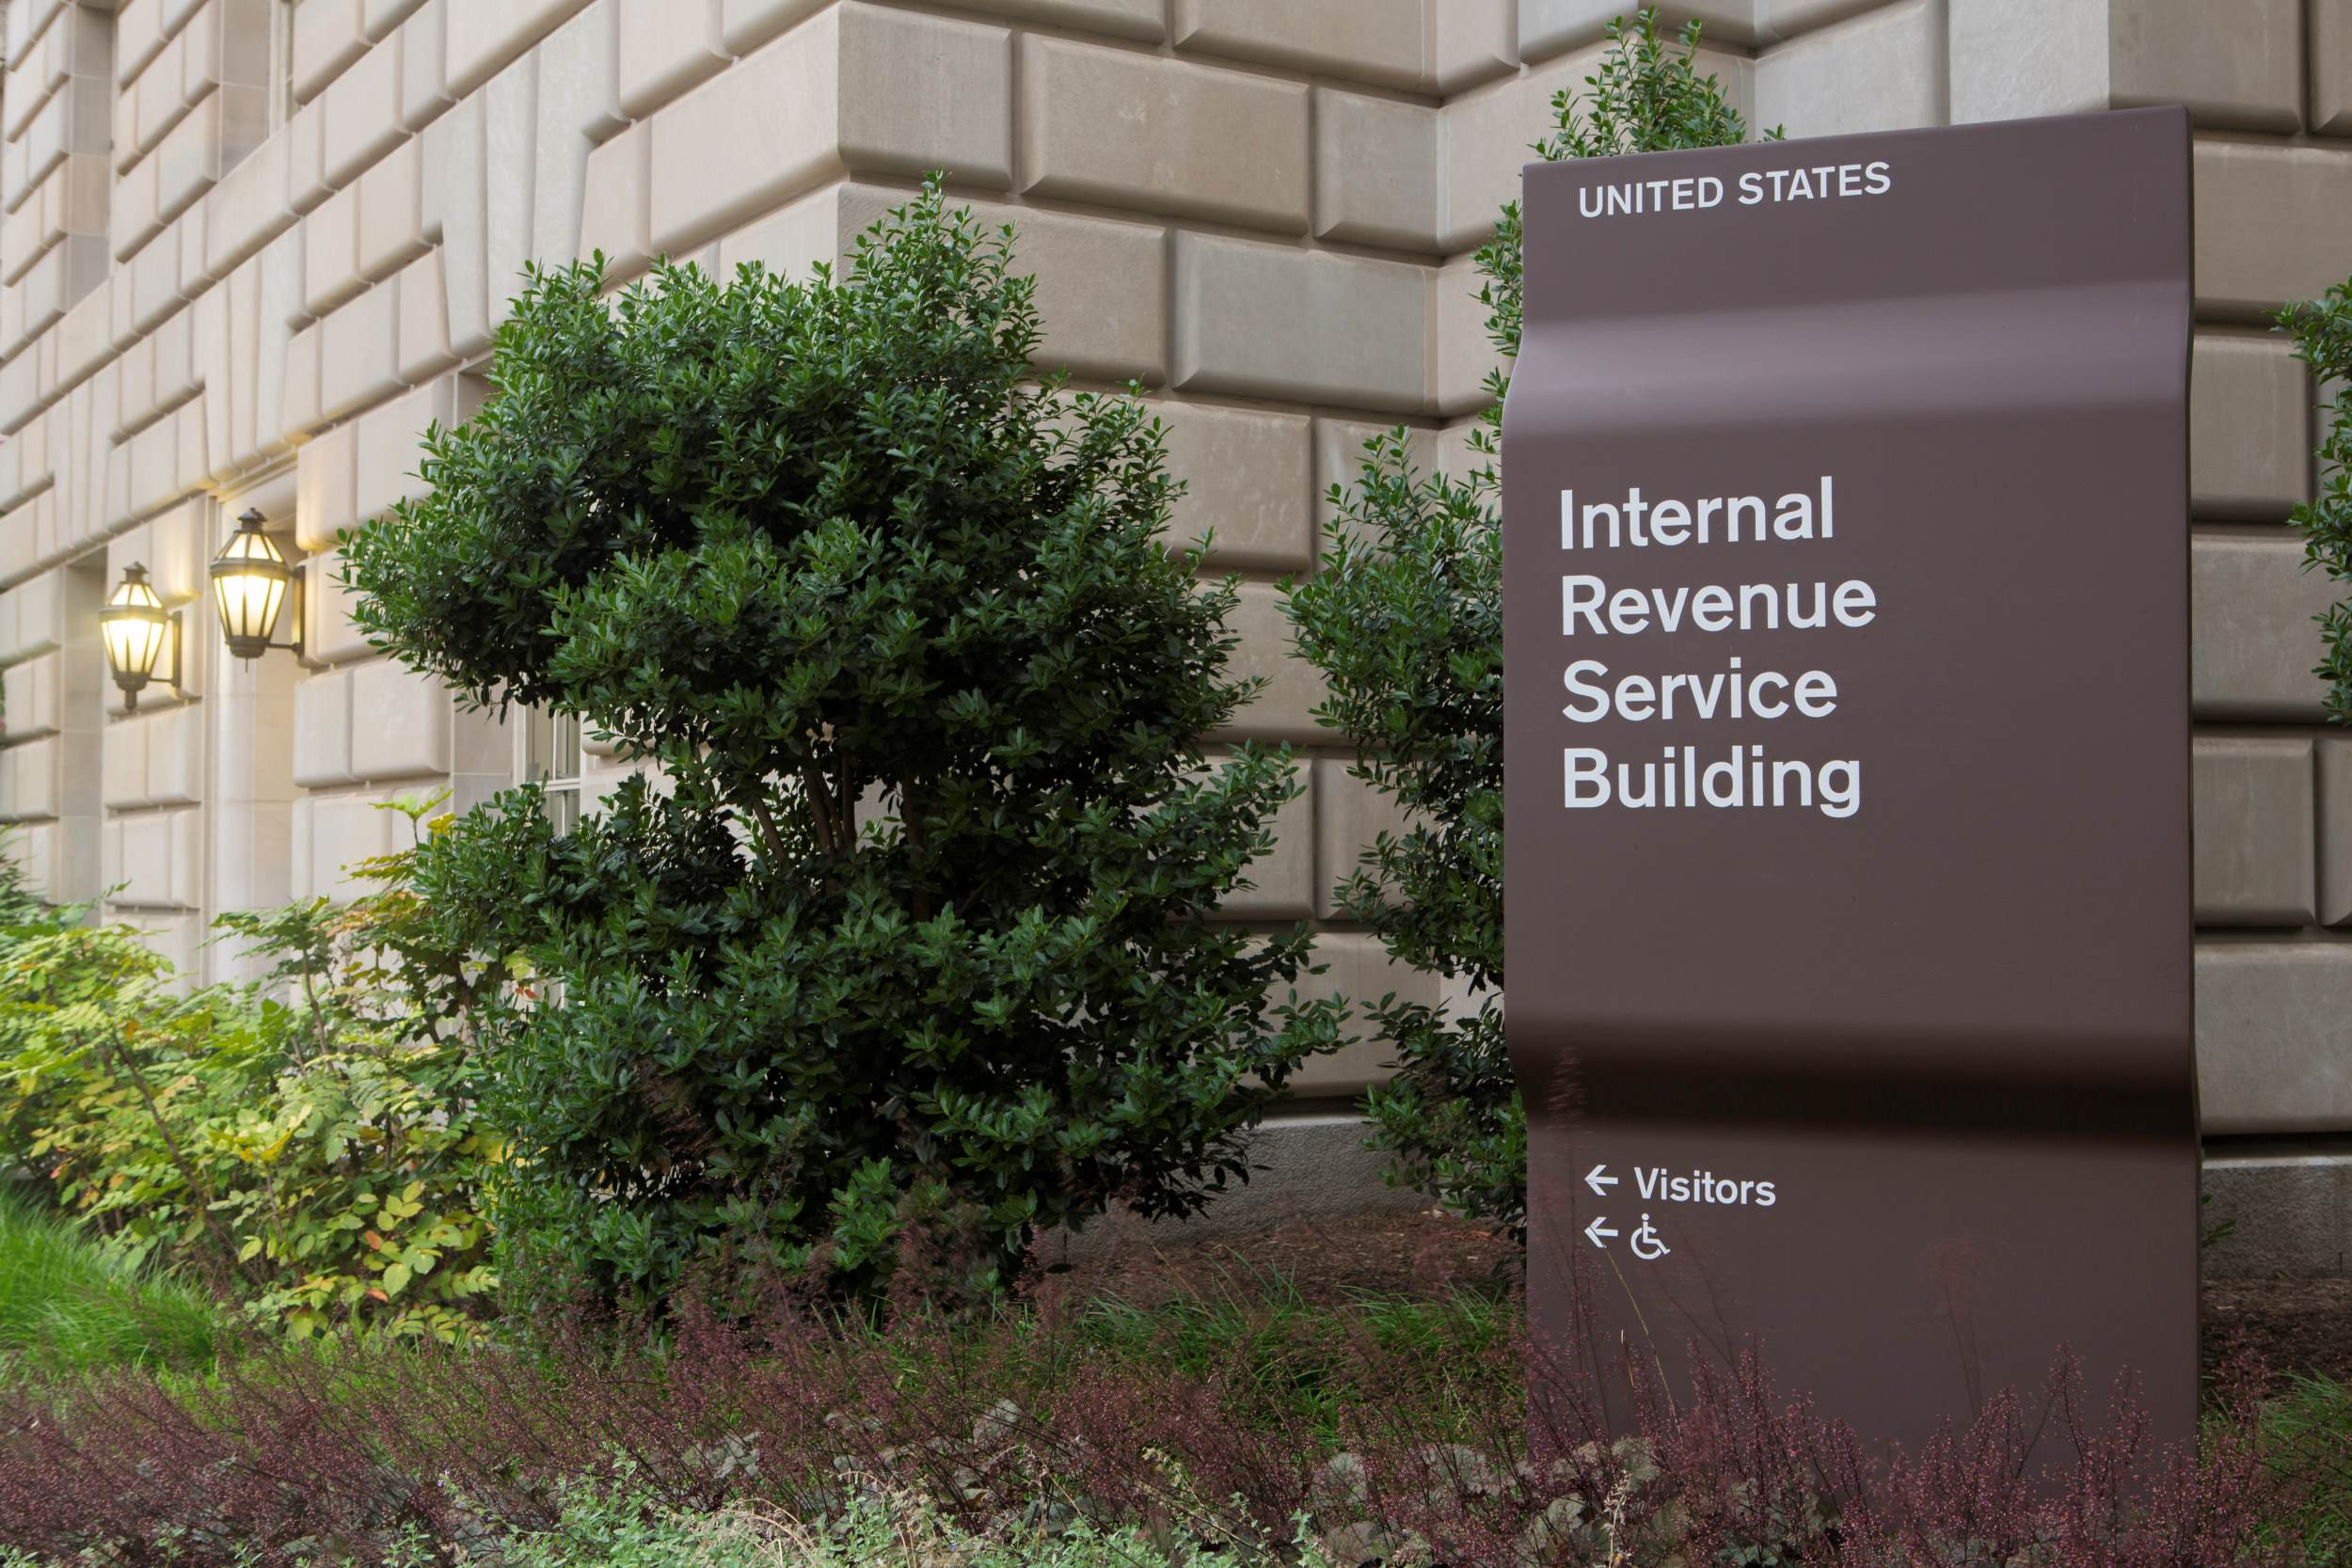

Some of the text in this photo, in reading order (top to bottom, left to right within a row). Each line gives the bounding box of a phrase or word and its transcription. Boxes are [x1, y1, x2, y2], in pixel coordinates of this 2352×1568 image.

[1580, 161, 1891, 218] UNITED STATES
[1561, 475, 1835, 550] Internal
[1562, 575, 1877, 637] Revenue
[1562, 657, 1837, 723] Service
[1564, 744, 1861, 818] Building
[1633, 1166, 1776, 1207] Visitors
